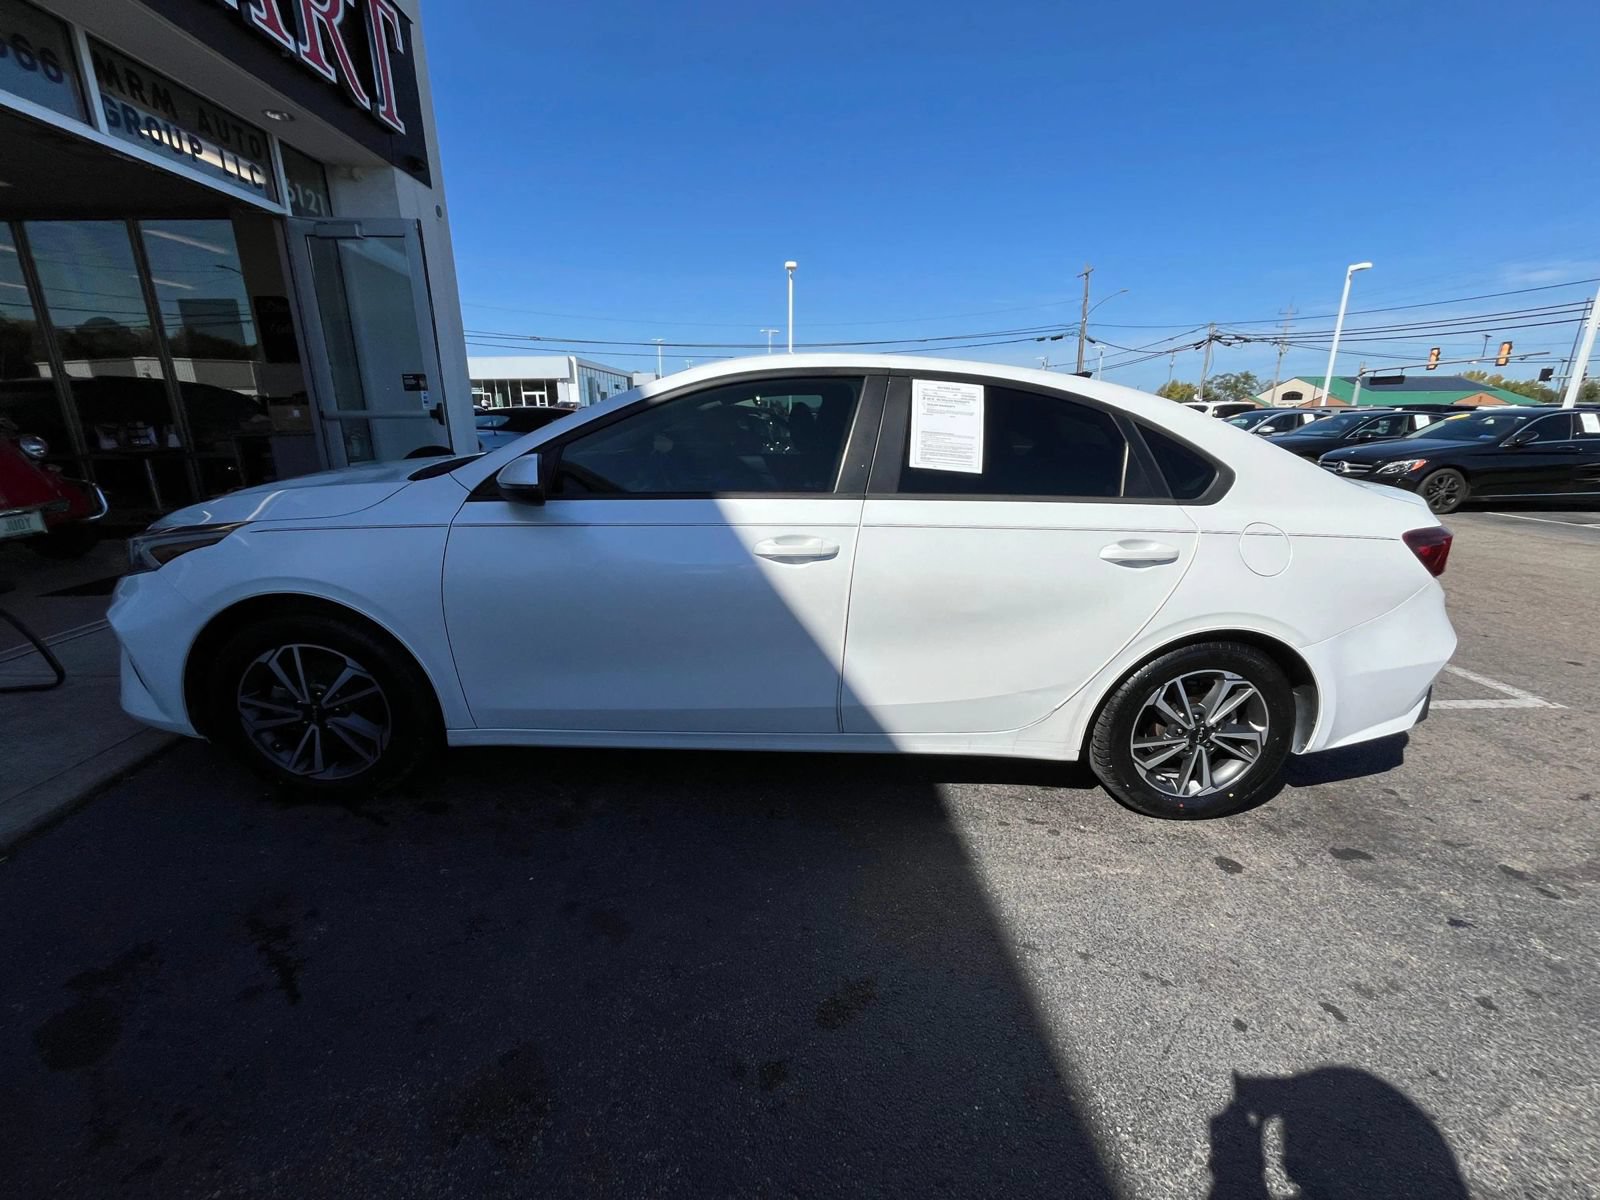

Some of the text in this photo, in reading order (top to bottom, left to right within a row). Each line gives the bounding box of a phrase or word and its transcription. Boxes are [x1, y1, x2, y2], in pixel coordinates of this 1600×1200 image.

[0, 33, 64, 84] 66
[94, 52, 262, 160] MRM AUTO
[102, 92, 266, 190] GROUP LLC
